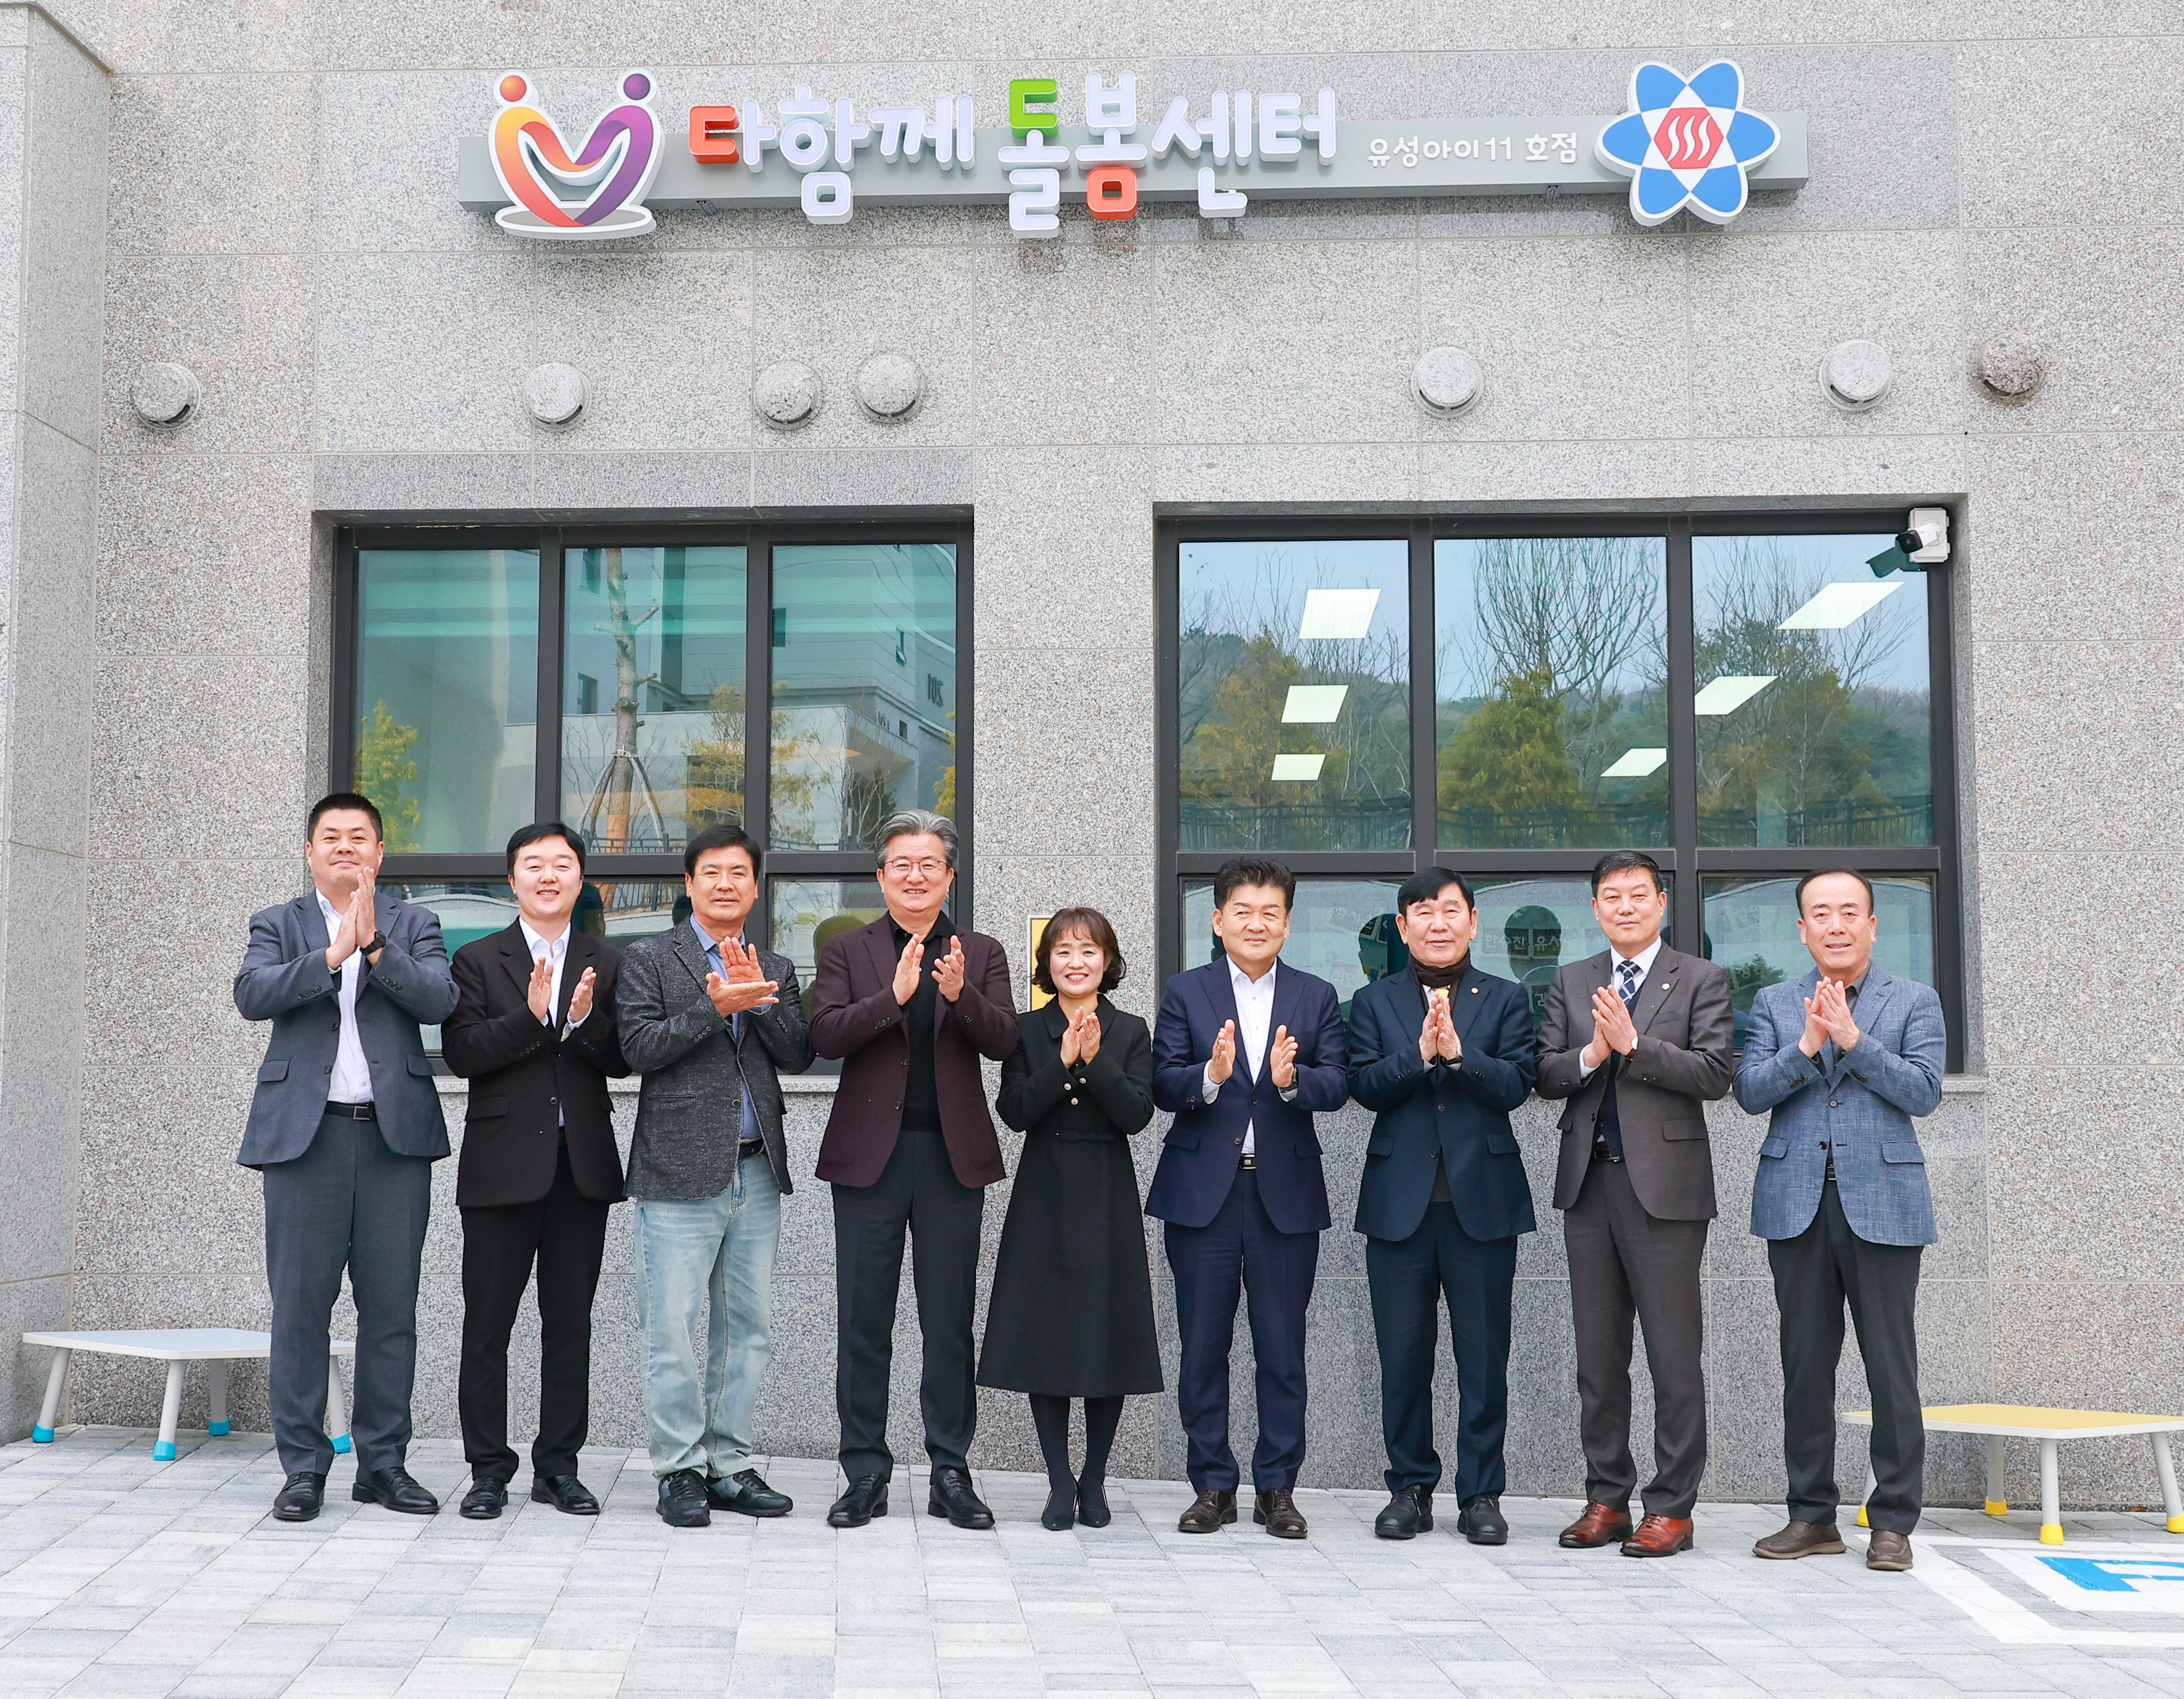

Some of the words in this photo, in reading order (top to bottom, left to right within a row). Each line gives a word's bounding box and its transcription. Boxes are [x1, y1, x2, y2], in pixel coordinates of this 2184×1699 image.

[689, 85, 975, 223] 다함께
[998, 70, 1336, 238] 돌봄센터
[1525, 132, 1577, 164] 호점
